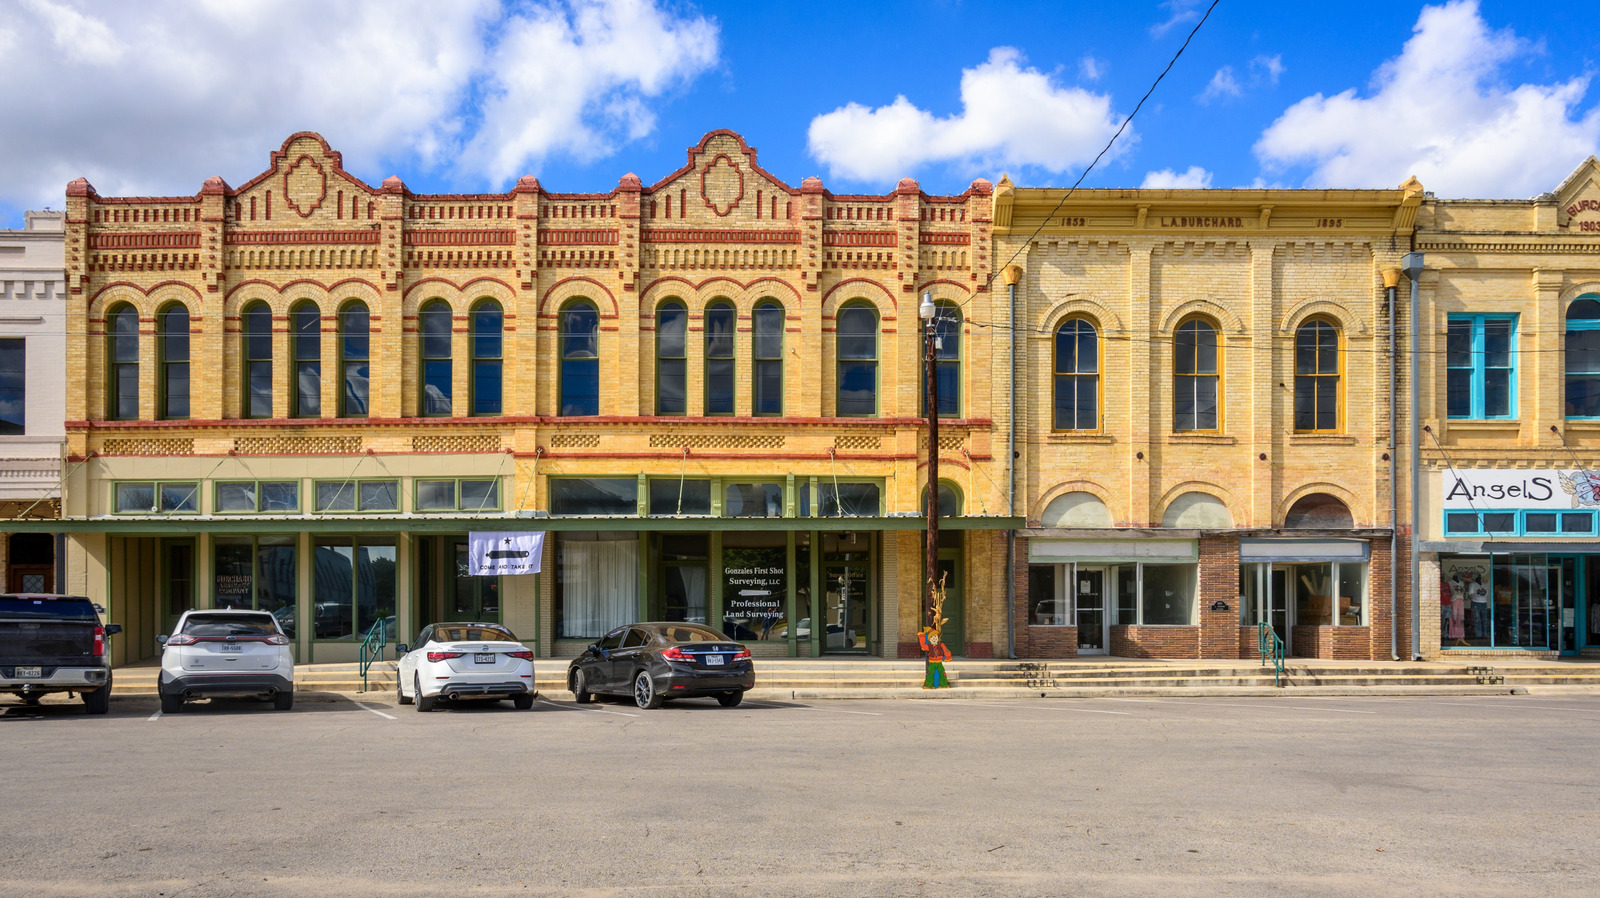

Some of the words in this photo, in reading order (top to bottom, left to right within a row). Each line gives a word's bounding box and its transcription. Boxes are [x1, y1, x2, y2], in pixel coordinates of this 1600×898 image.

[1559, 217, 1572, 228] L.
[1567, 200, 1600, 217] BURC
[1061, 218, 1085, 227] 1852
[1317, 218, 1342, 228] 1895
[1446, 477, 1553, 501] AngelS
[729, 578, 768, 586] Surveying,
[746, 611, 784, 619] Surveying
